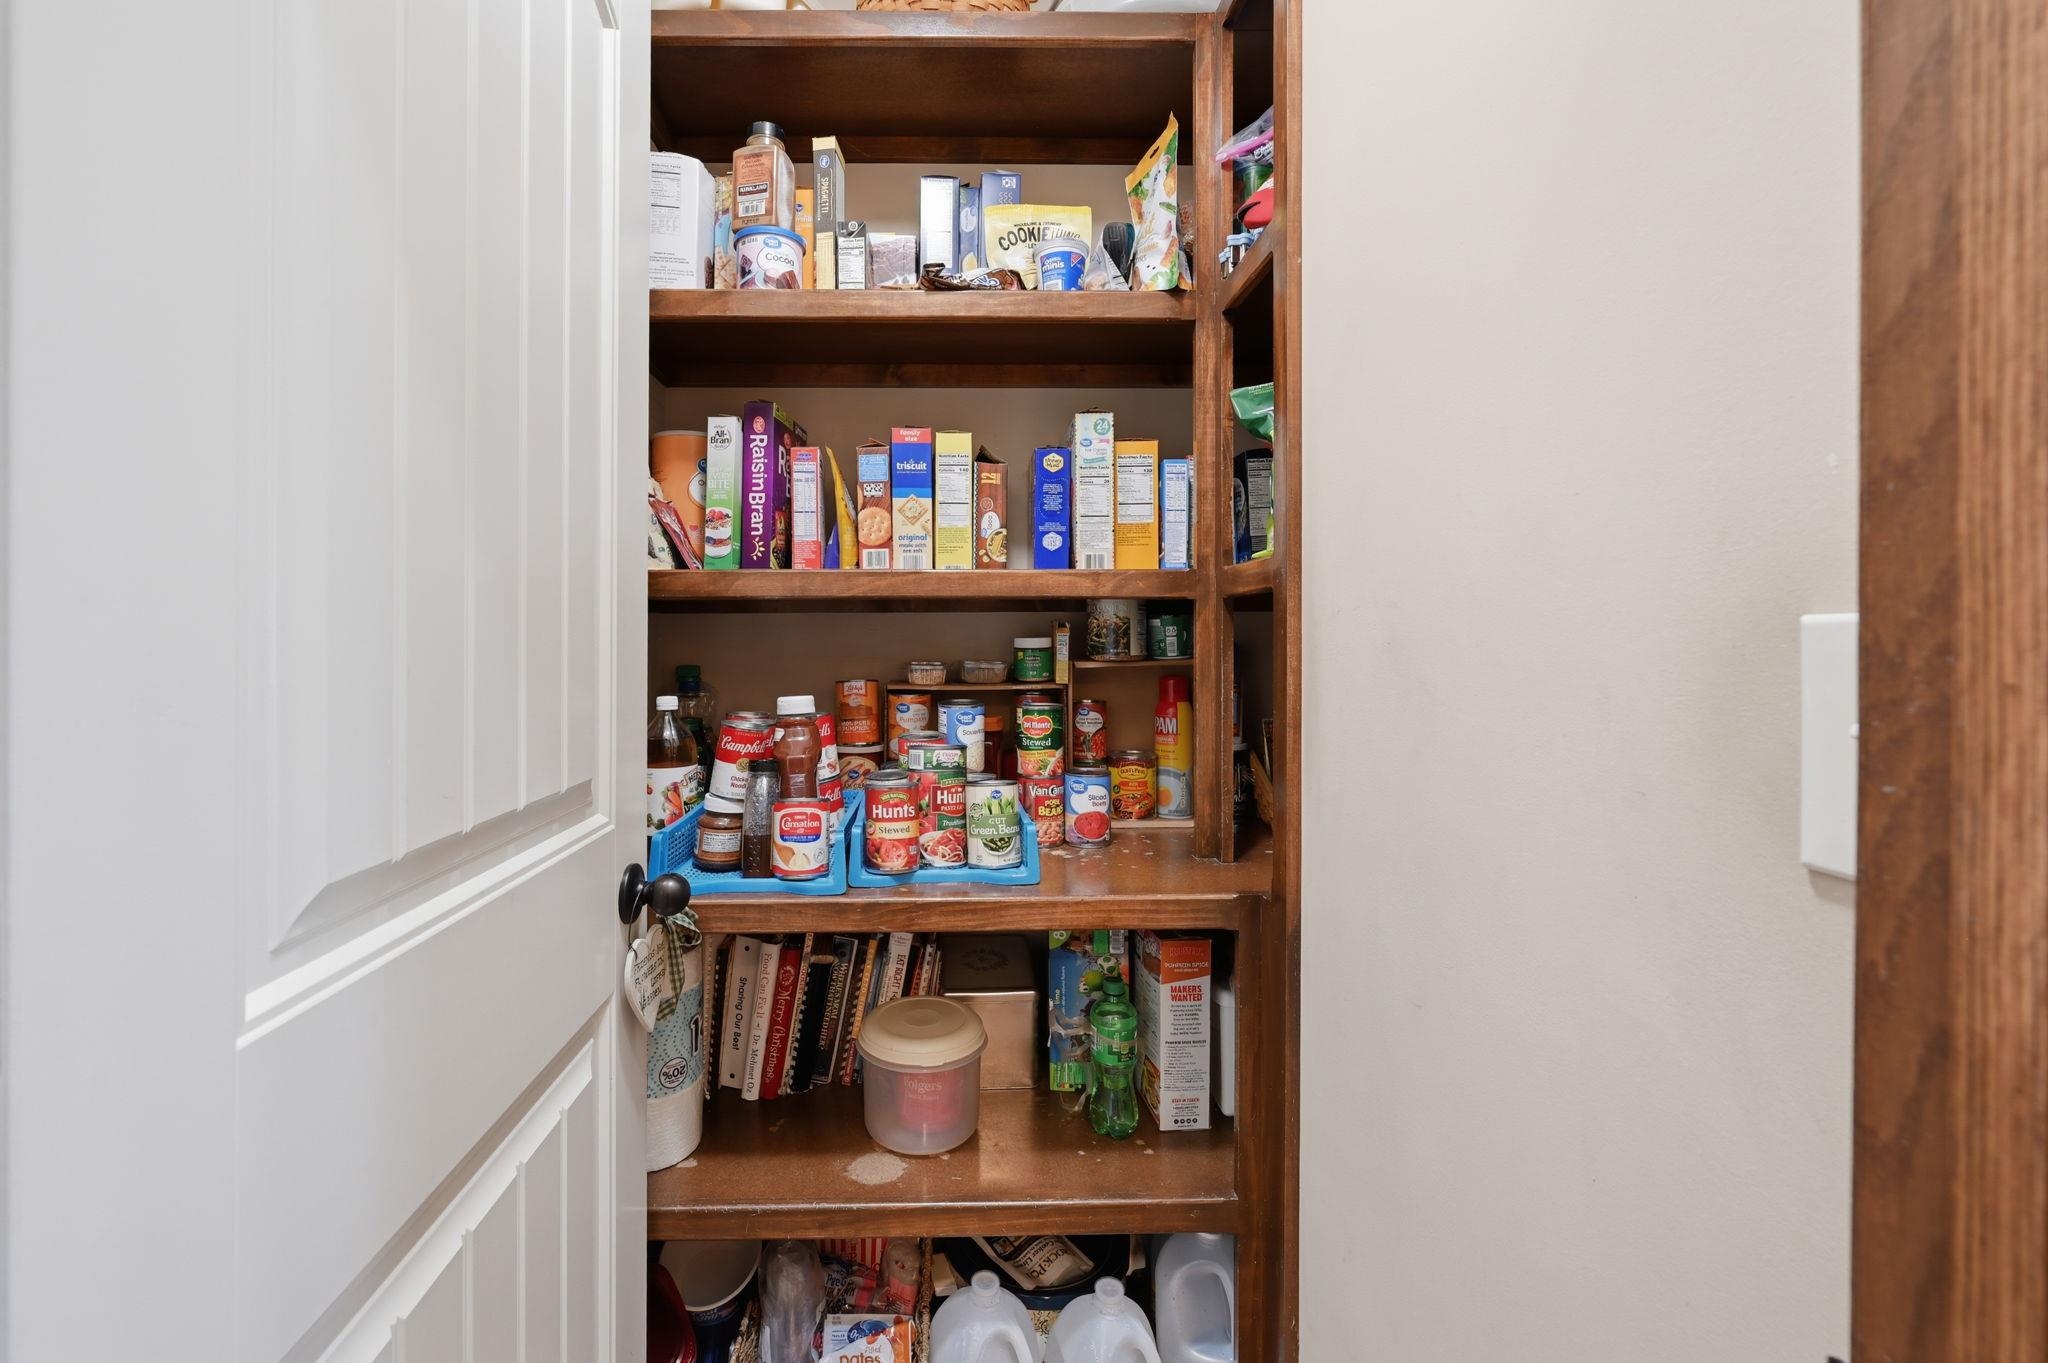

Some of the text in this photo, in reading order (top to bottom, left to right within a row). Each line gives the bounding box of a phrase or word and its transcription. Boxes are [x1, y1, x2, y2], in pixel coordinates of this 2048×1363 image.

[739, 183, 768, 193] KIRKLAND
[820, 177, 829, 213] SPAGHETTI
[998, 226, 1050, 251] COOKIE
[765, 252, 795, 267] Cocoa
[1042, 261, 1065, 272] minis
[1096, 420, 1109, 430] 24
[710, 436, 729, 444] Bran
[715, 430, 727, 438] All-
[896, 460, 927, 470] triscuit
[708, 480, 730, 489] BITE
[748, 434, 768, 536] Raisin Bran
[898, 533, 928, 543] original
[1031, 721, 1051, 729] Monte
[1155, 716, 1177, 735] PAM
[1022, 737, 1052, 746] Stewed
[1028, 785, 1048, 797] Van
[872, 802, 916, 819] Hunt's
[781, 816, 820, 831] Carnation
[988, 817, 1007, 825] CUT
[878, 825, 911, 834] Stewed
[970, 824, 998, 835] Green
[1053, 931, 1067, 939] 8
[891, 953, 906, 989] EAT RIGHT
[827, 981, 837, 1001] THAT
[831, 962, 849, 1019] WHERE'S MOM
[1170, 985, 1202, 994] MAKERS
[1171, 993, 1203, 1002] WANTED
[732, 976, 748, 1051] Sharing Our Best
[822, 1005, 832, 1028] NEED
[748, 953, 772, 1094] Food Can Fix It Dr. Mehmet Oz
[766, 985, 794, 1083] Merry Christmas
[817, 1028, 827, 1051] HER?
[662, 1064, 687, 1081] 20%
